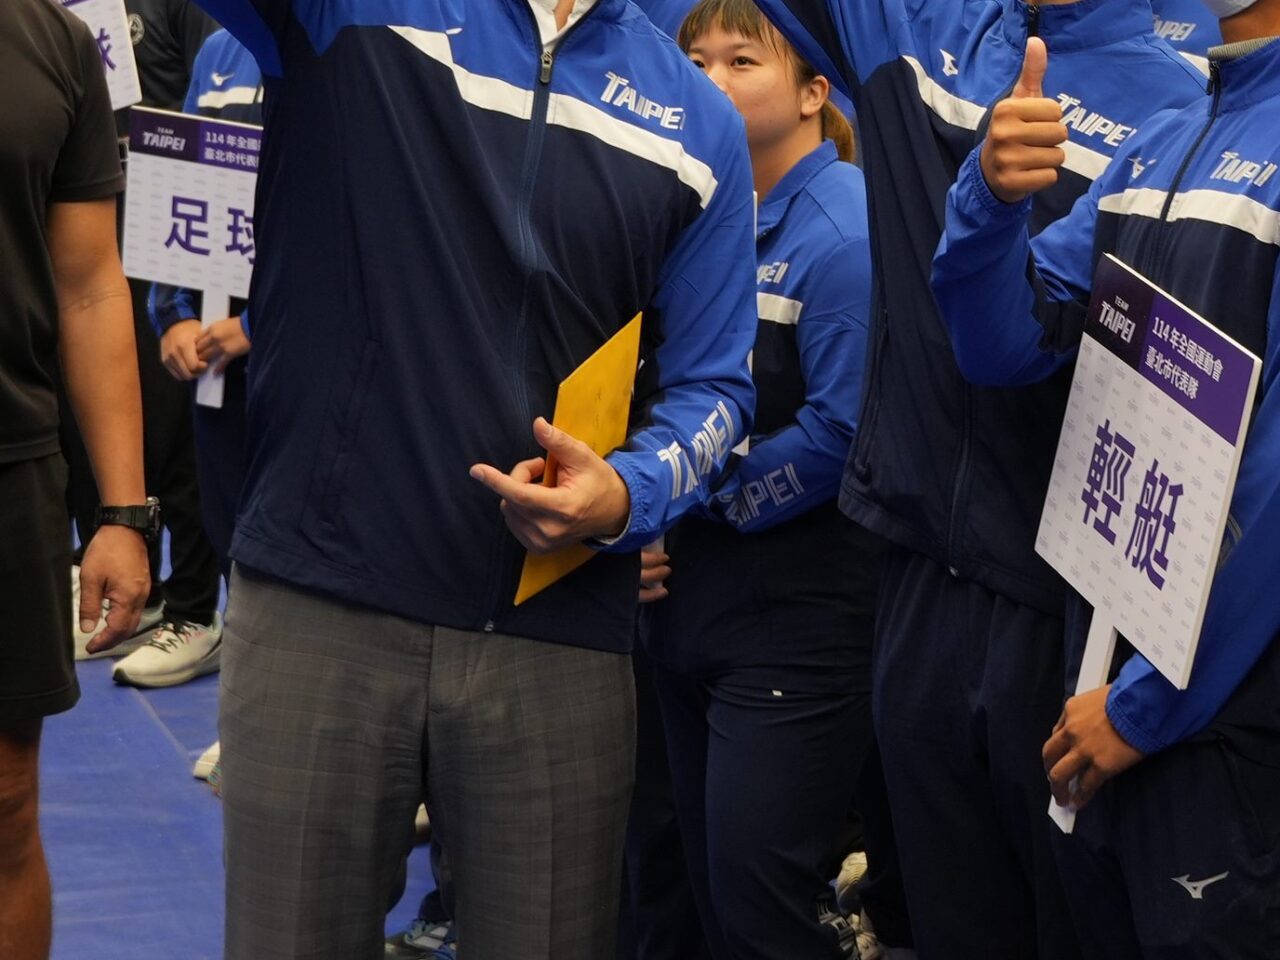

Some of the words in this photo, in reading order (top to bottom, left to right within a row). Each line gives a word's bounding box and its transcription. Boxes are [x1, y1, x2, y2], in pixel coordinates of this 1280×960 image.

[142, 131, 186, 152] TAIPEI
[1099, 300, 1136, 344] TAIPEI
[1114, 295, 1130, 312] TEAM
[1144, 344, 1200, 400] 臺北市代表隊
[1080, 418, 1184, 591] 輕艇
